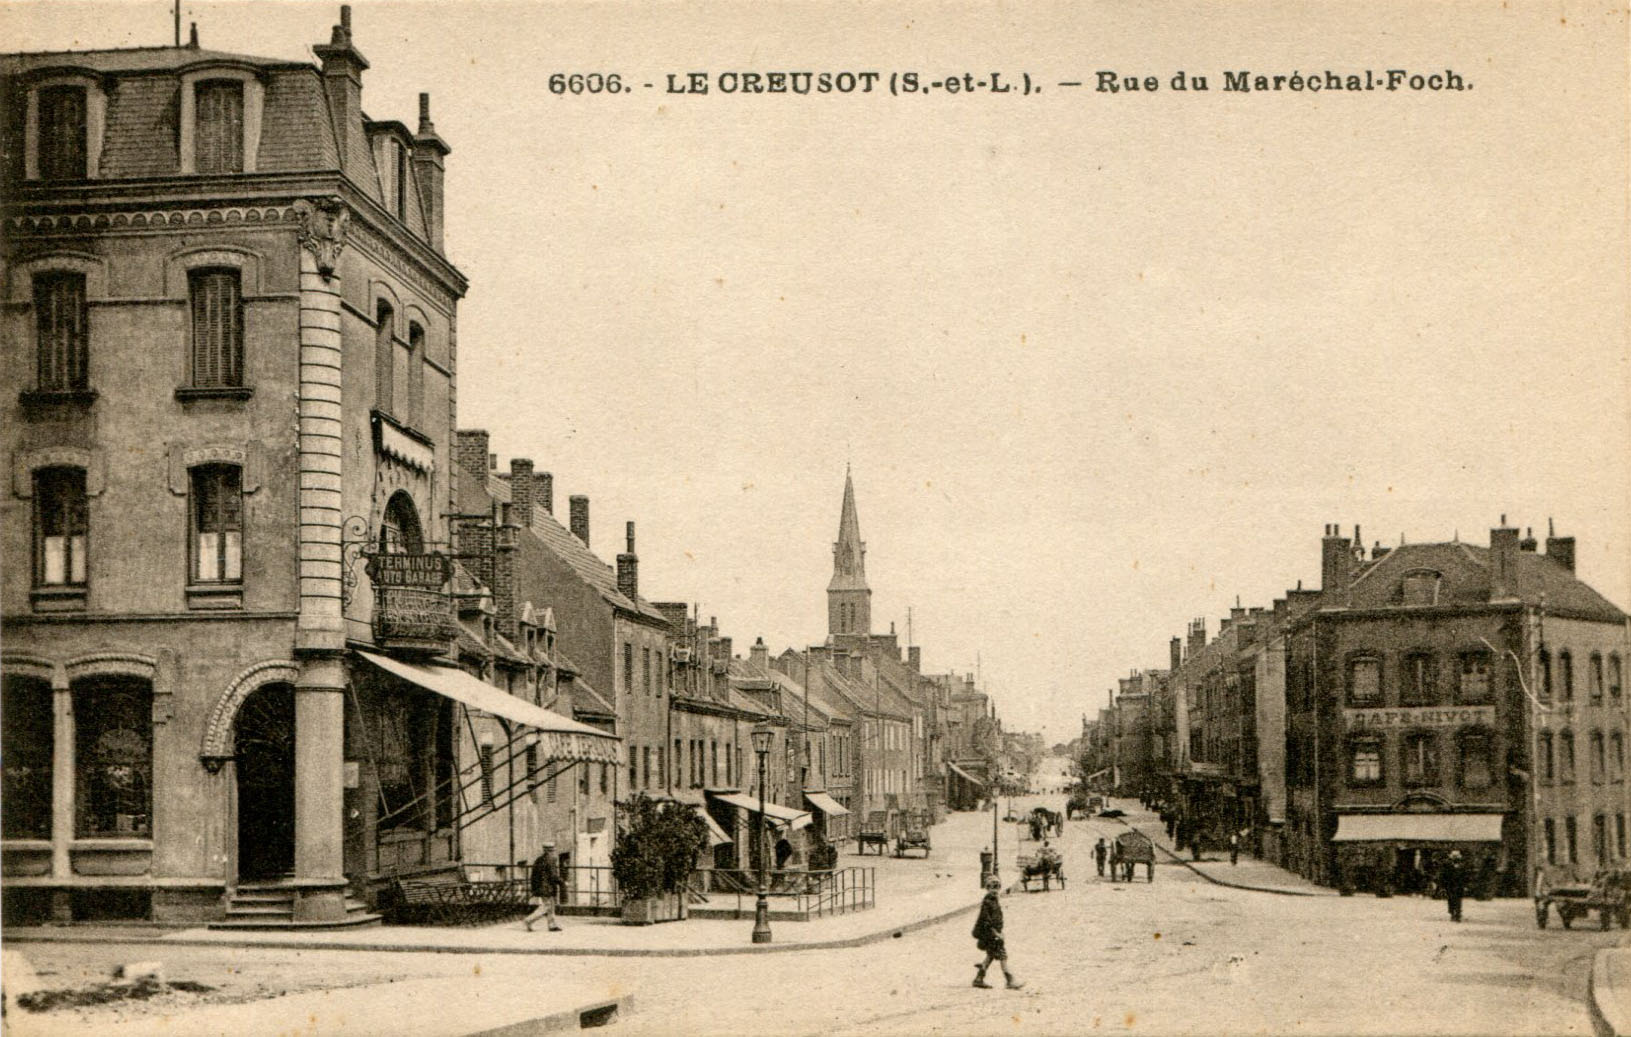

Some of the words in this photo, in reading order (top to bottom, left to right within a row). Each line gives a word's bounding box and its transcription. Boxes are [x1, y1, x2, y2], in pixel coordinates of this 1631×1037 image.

[378, 556, 442, 570] TERMINUS
[375, 569, 402, 583] AUTO
[405, 570, 442, 585] GARAGE
